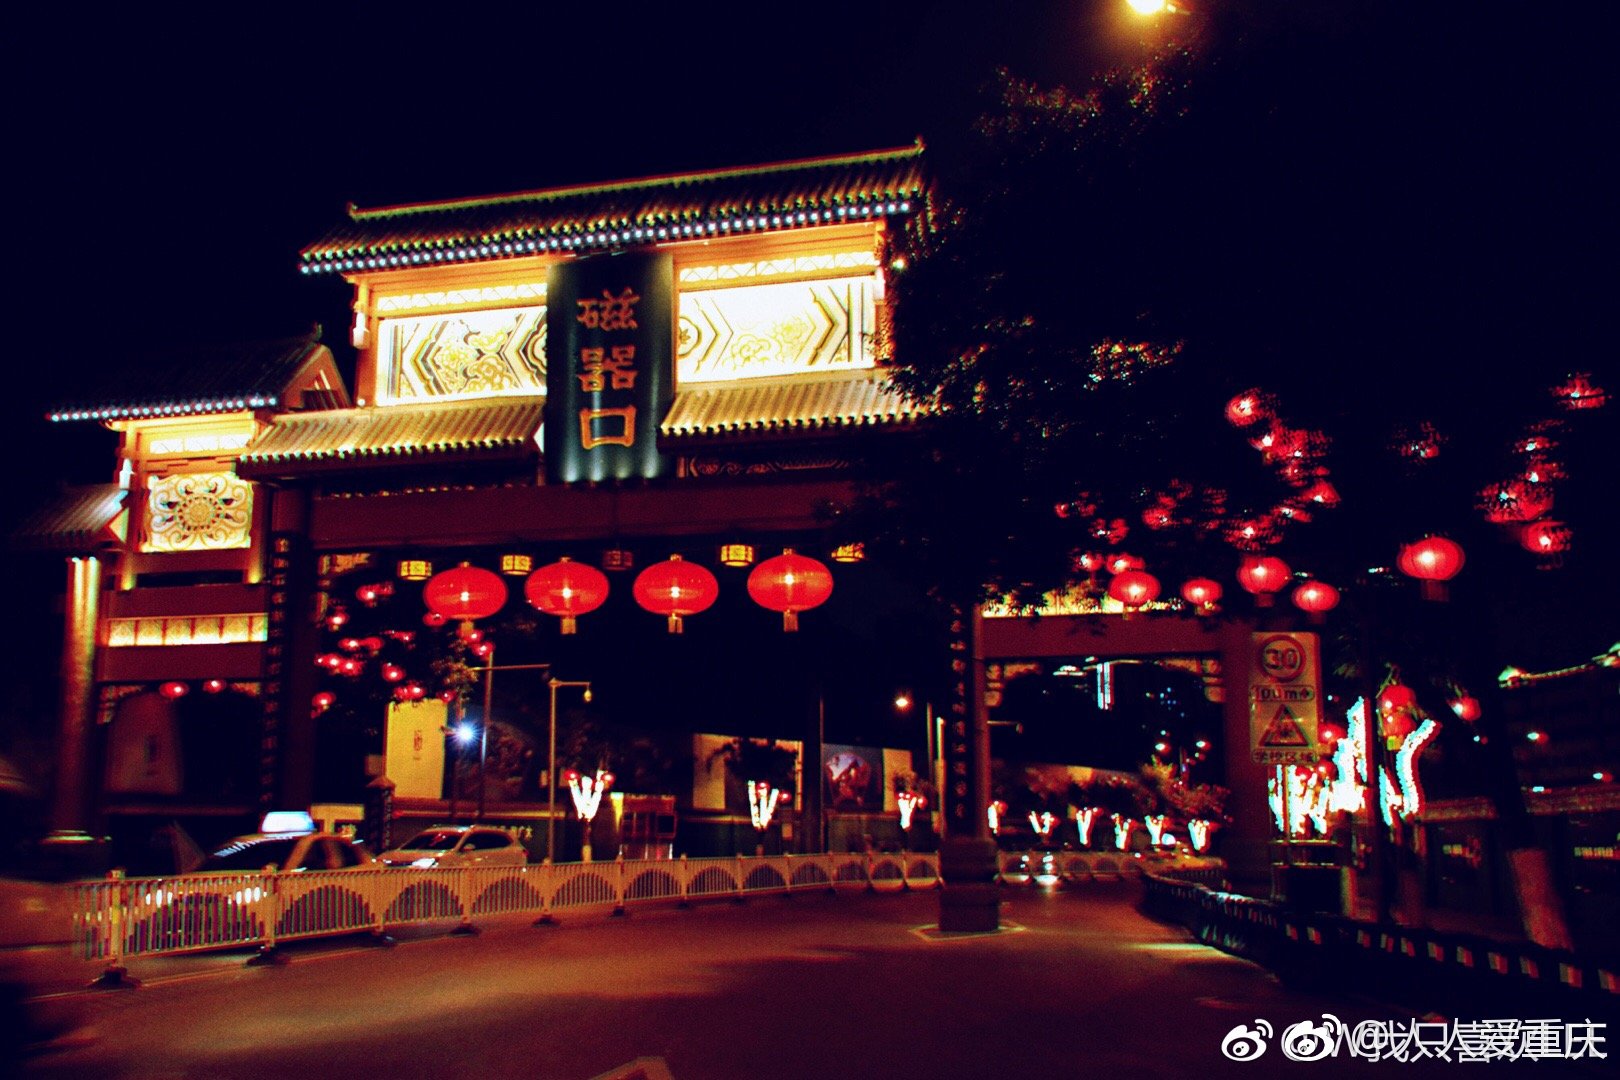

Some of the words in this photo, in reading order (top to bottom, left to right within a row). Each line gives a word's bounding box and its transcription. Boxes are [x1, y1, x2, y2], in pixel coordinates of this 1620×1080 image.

[576, 286, 640, 450] 磁器口
[1265, 648, 1299, 670] 30
